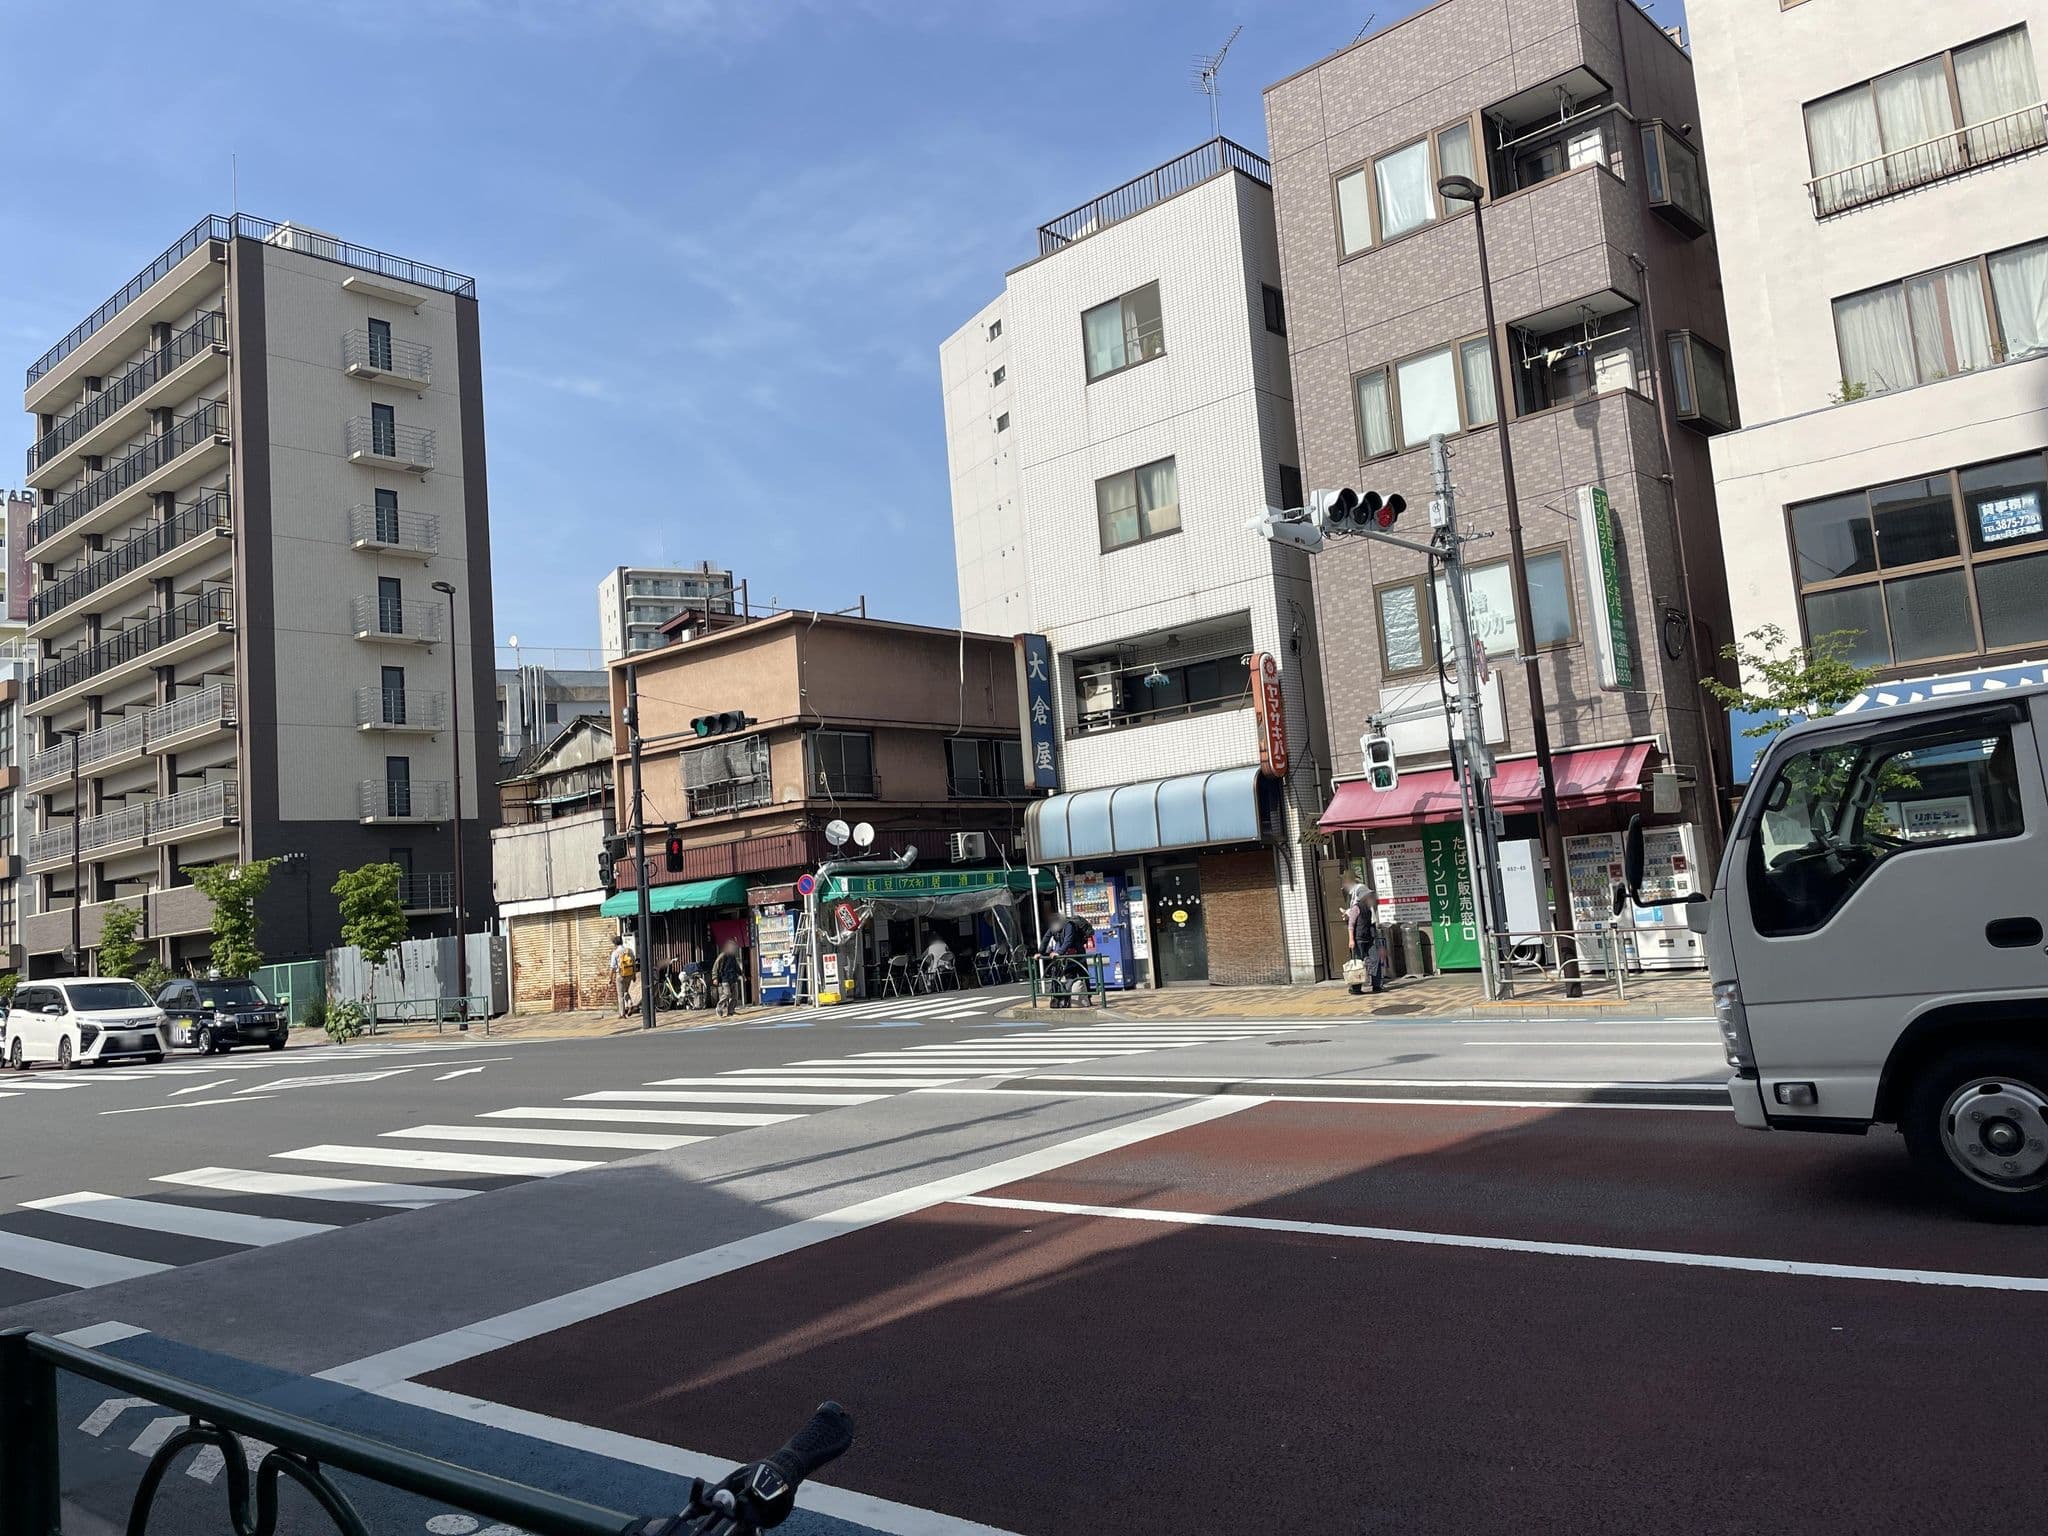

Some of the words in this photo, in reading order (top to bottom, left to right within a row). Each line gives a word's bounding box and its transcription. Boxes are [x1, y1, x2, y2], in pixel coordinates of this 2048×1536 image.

[1028, 651, 1055, 771] 大倉屋
[1266, 684, 1286, 769] ヤマザキパン
[1430, 839, 1452, 942] コインロッカー
[1452, 836, 1476, 941] たばこ販売窓口
